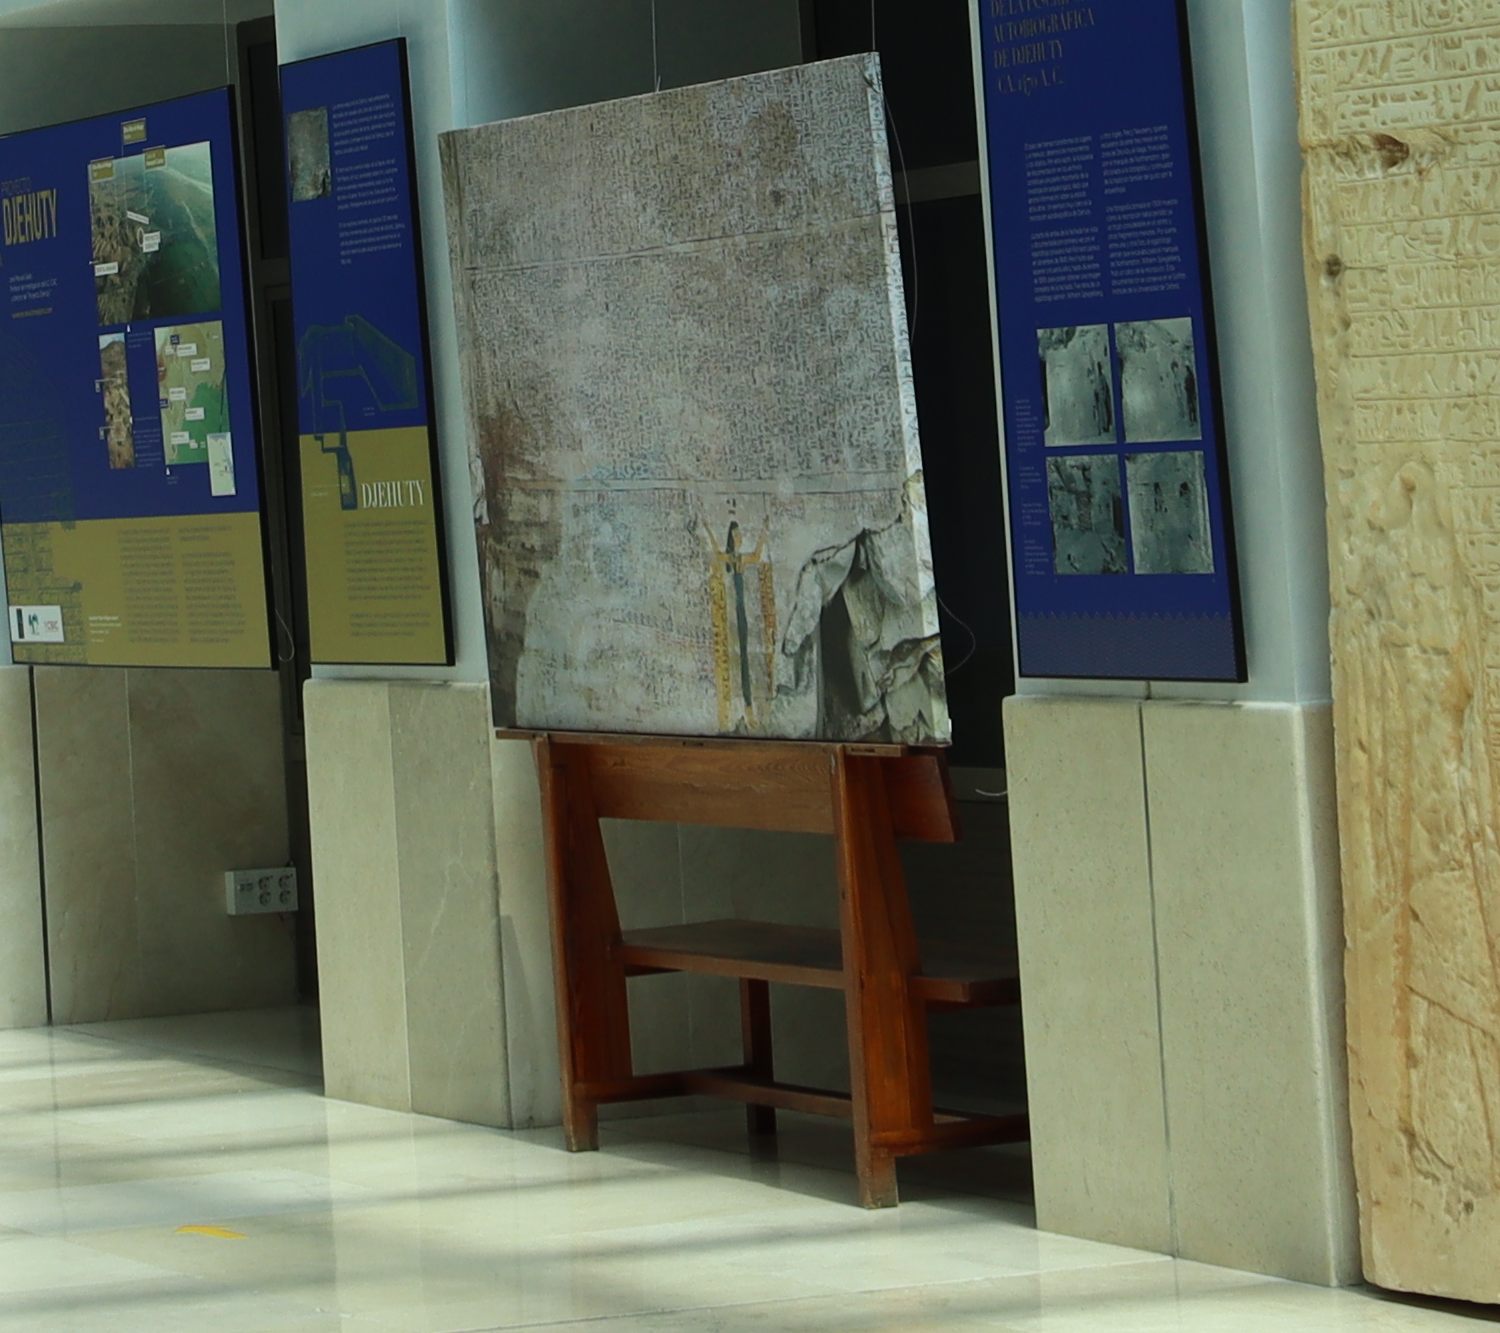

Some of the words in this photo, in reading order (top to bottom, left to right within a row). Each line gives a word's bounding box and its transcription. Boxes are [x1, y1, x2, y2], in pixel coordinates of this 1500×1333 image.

[994, 7, 1095, 43] AUTOBIOGRÁFICA
[994, 48, 1009, 69] DE
[1011, 39, 1063, 66] DJEHUTY
[3, 188, 56, 245] DJEHUTY
[362, 480, 424, 508] DJEHUTY
